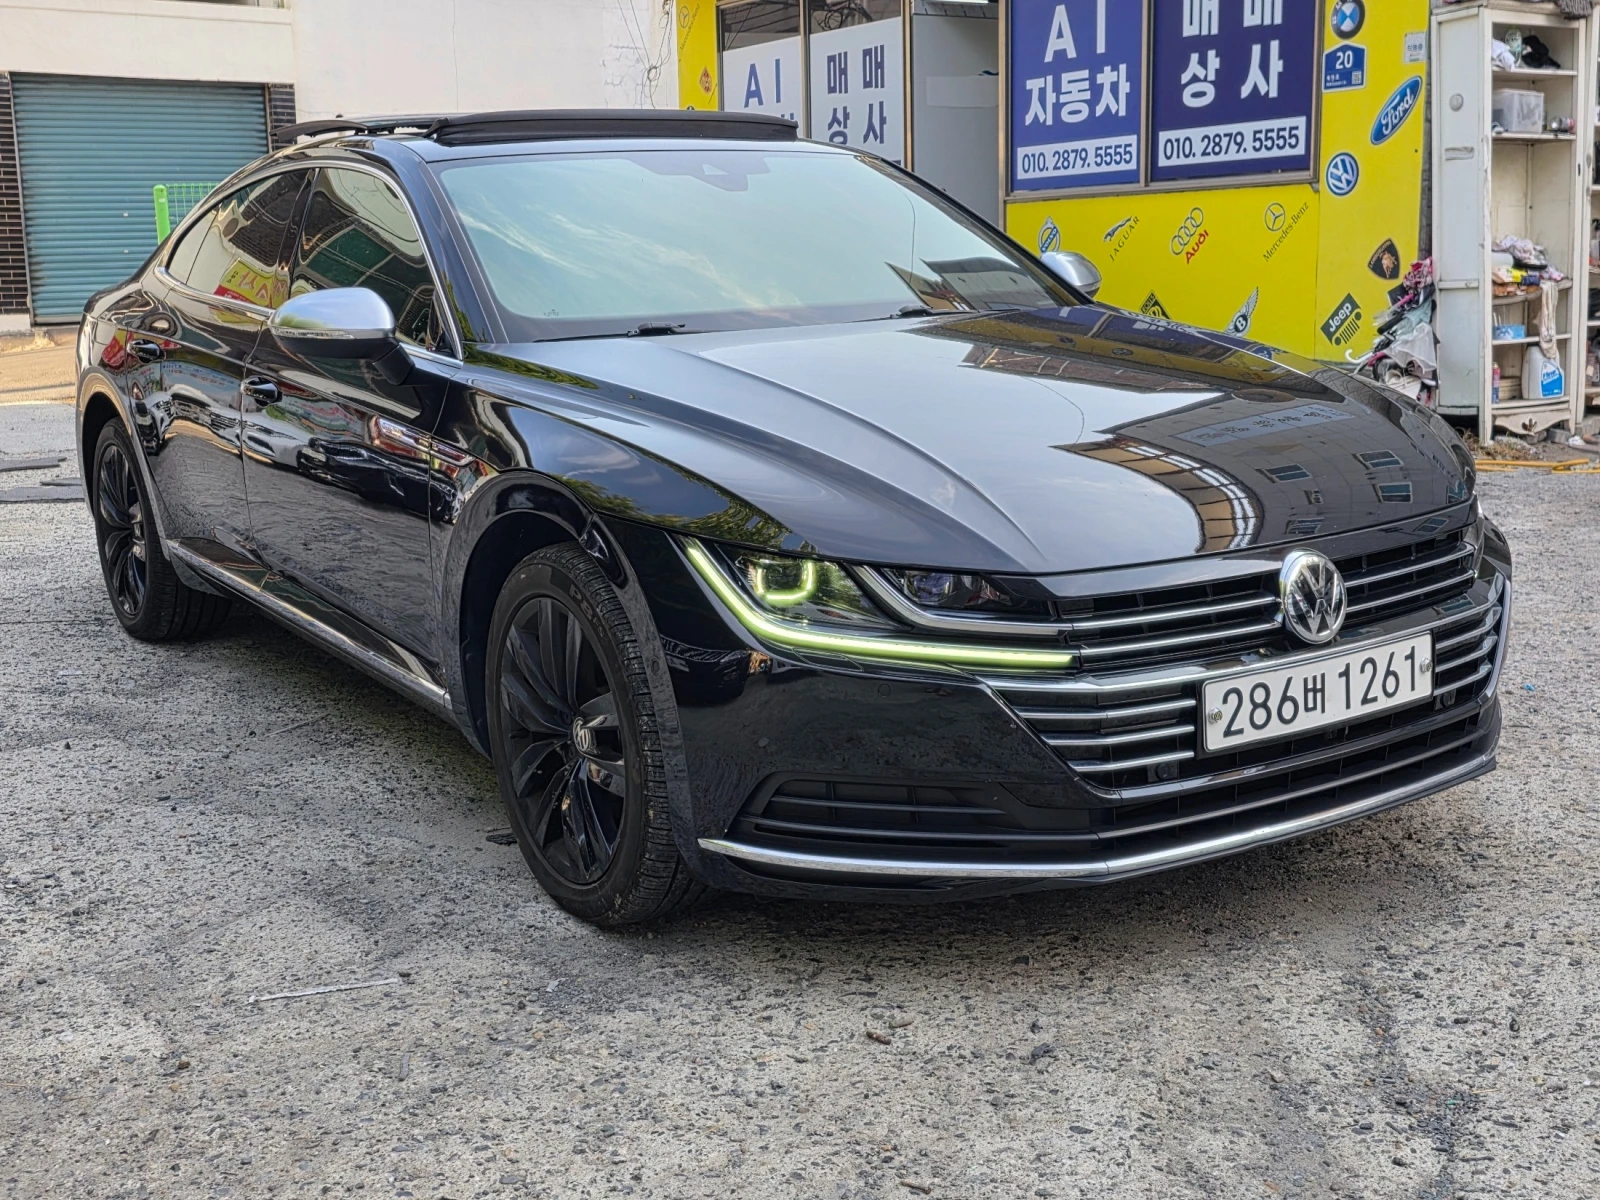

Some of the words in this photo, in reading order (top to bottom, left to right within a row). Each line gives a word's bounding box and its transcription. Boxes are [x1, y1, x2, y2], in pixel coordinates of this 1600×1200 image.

[744, 58, 782, 108] AI
[826, 44, 885, 95] 매매
[1180, 39, 1284, 108] 상사
[1335, 50, 1353, 70] 20
[1025, 63, 1130, 126] 자동차
[1381, 87, 1414, 136] Ford
[827, 100, 887, 145] 상사
[1108, 215, 1141, 262] JAGUAR
[1184, 229, 1210, 265] Audi
[1235, 316, 1247, 331] B
[1328, 301, 1352, 334] Jeep
[1222, 672, 1326, 738] 286버
[1338, 645, 1417, 710] 1261
